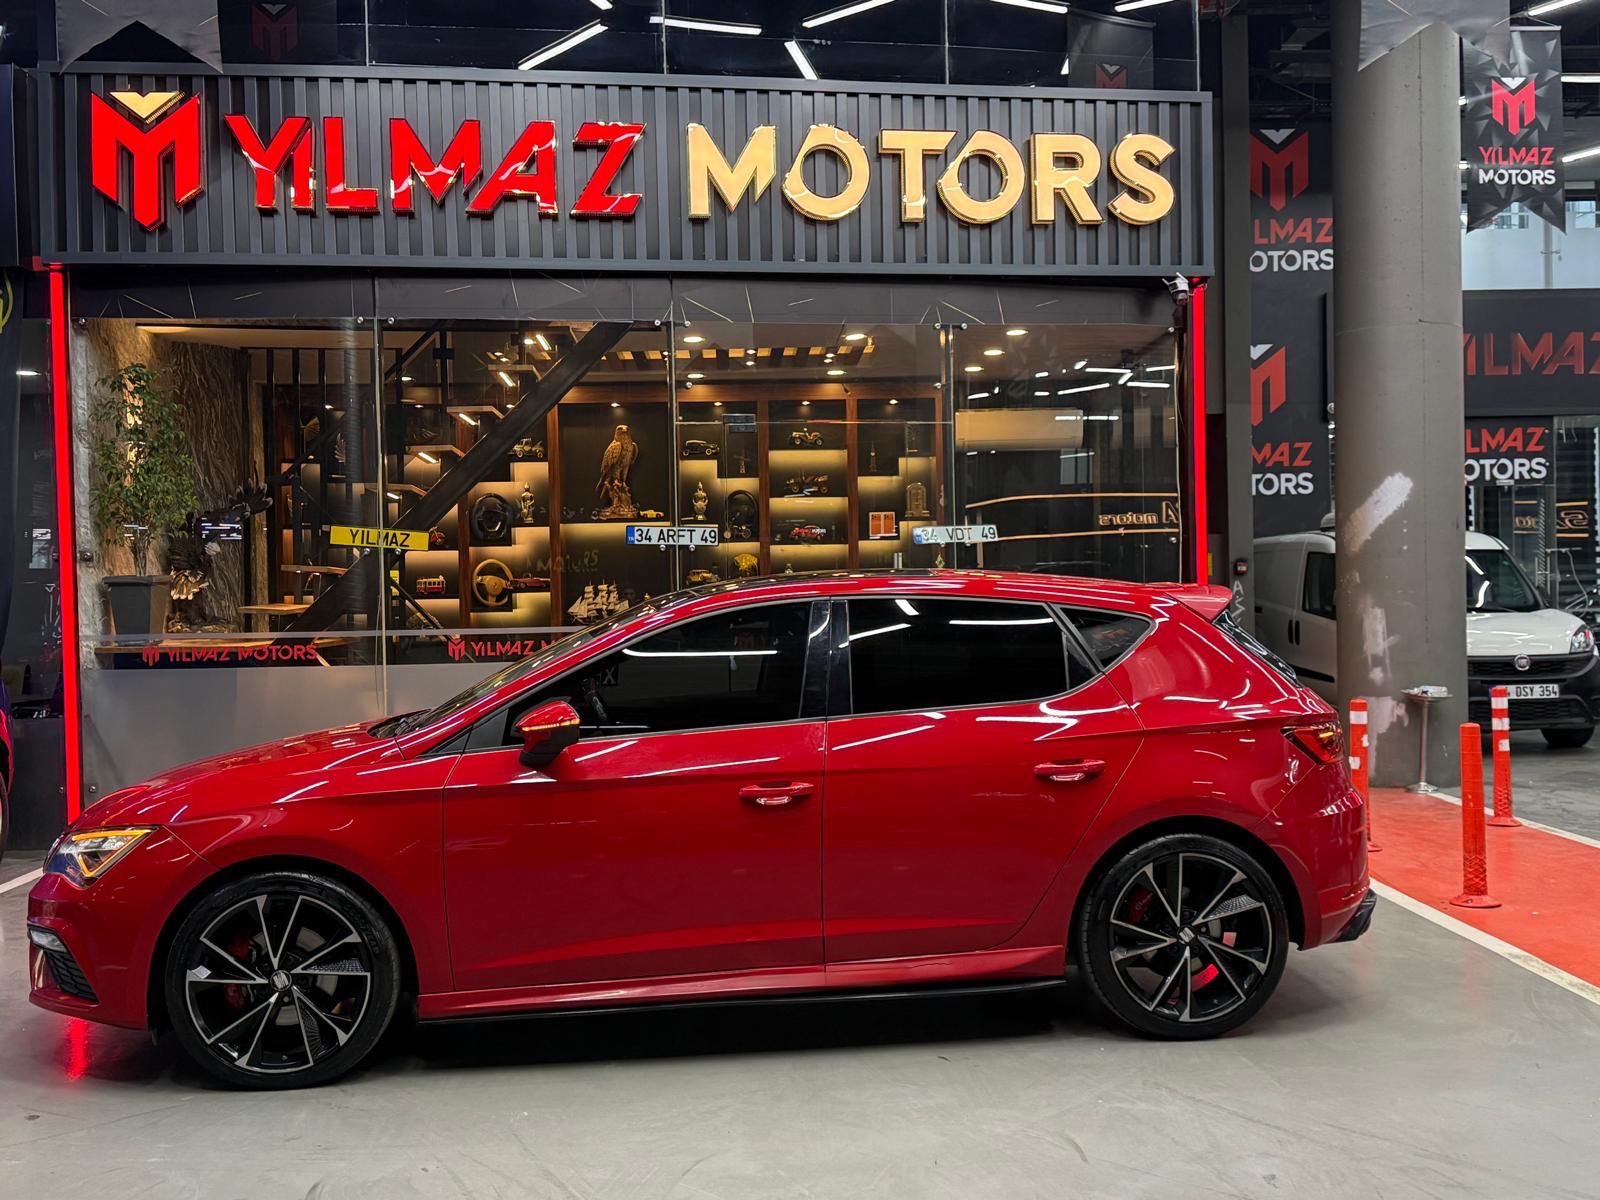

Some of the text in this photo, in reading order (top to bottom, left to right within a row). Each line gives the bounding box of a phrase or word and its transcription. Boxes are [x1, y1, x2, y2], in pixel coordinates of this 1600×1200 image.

[1478, 146, 1554, 166] YILMAZ
[224, 113, 646, 219] YILMAZ
[686, 122, 1176, 226] MOTORS
[1478, 169, 1556, 185] MOTORS
[1249, 249, 1334, 272] OTORS
[1464, 458, 1547, 480] OTORS
[350, 529, 410, 547] YILMAZ
[636, 528, 717, 543] 34 ARFT 49
[946, 527, 972, 541] VDT
[981, 526, 996, 540] 49
[165, 645, 317, 662] YILMAZ MOTORS
[470, 640, 535, 657] YILMAZ
